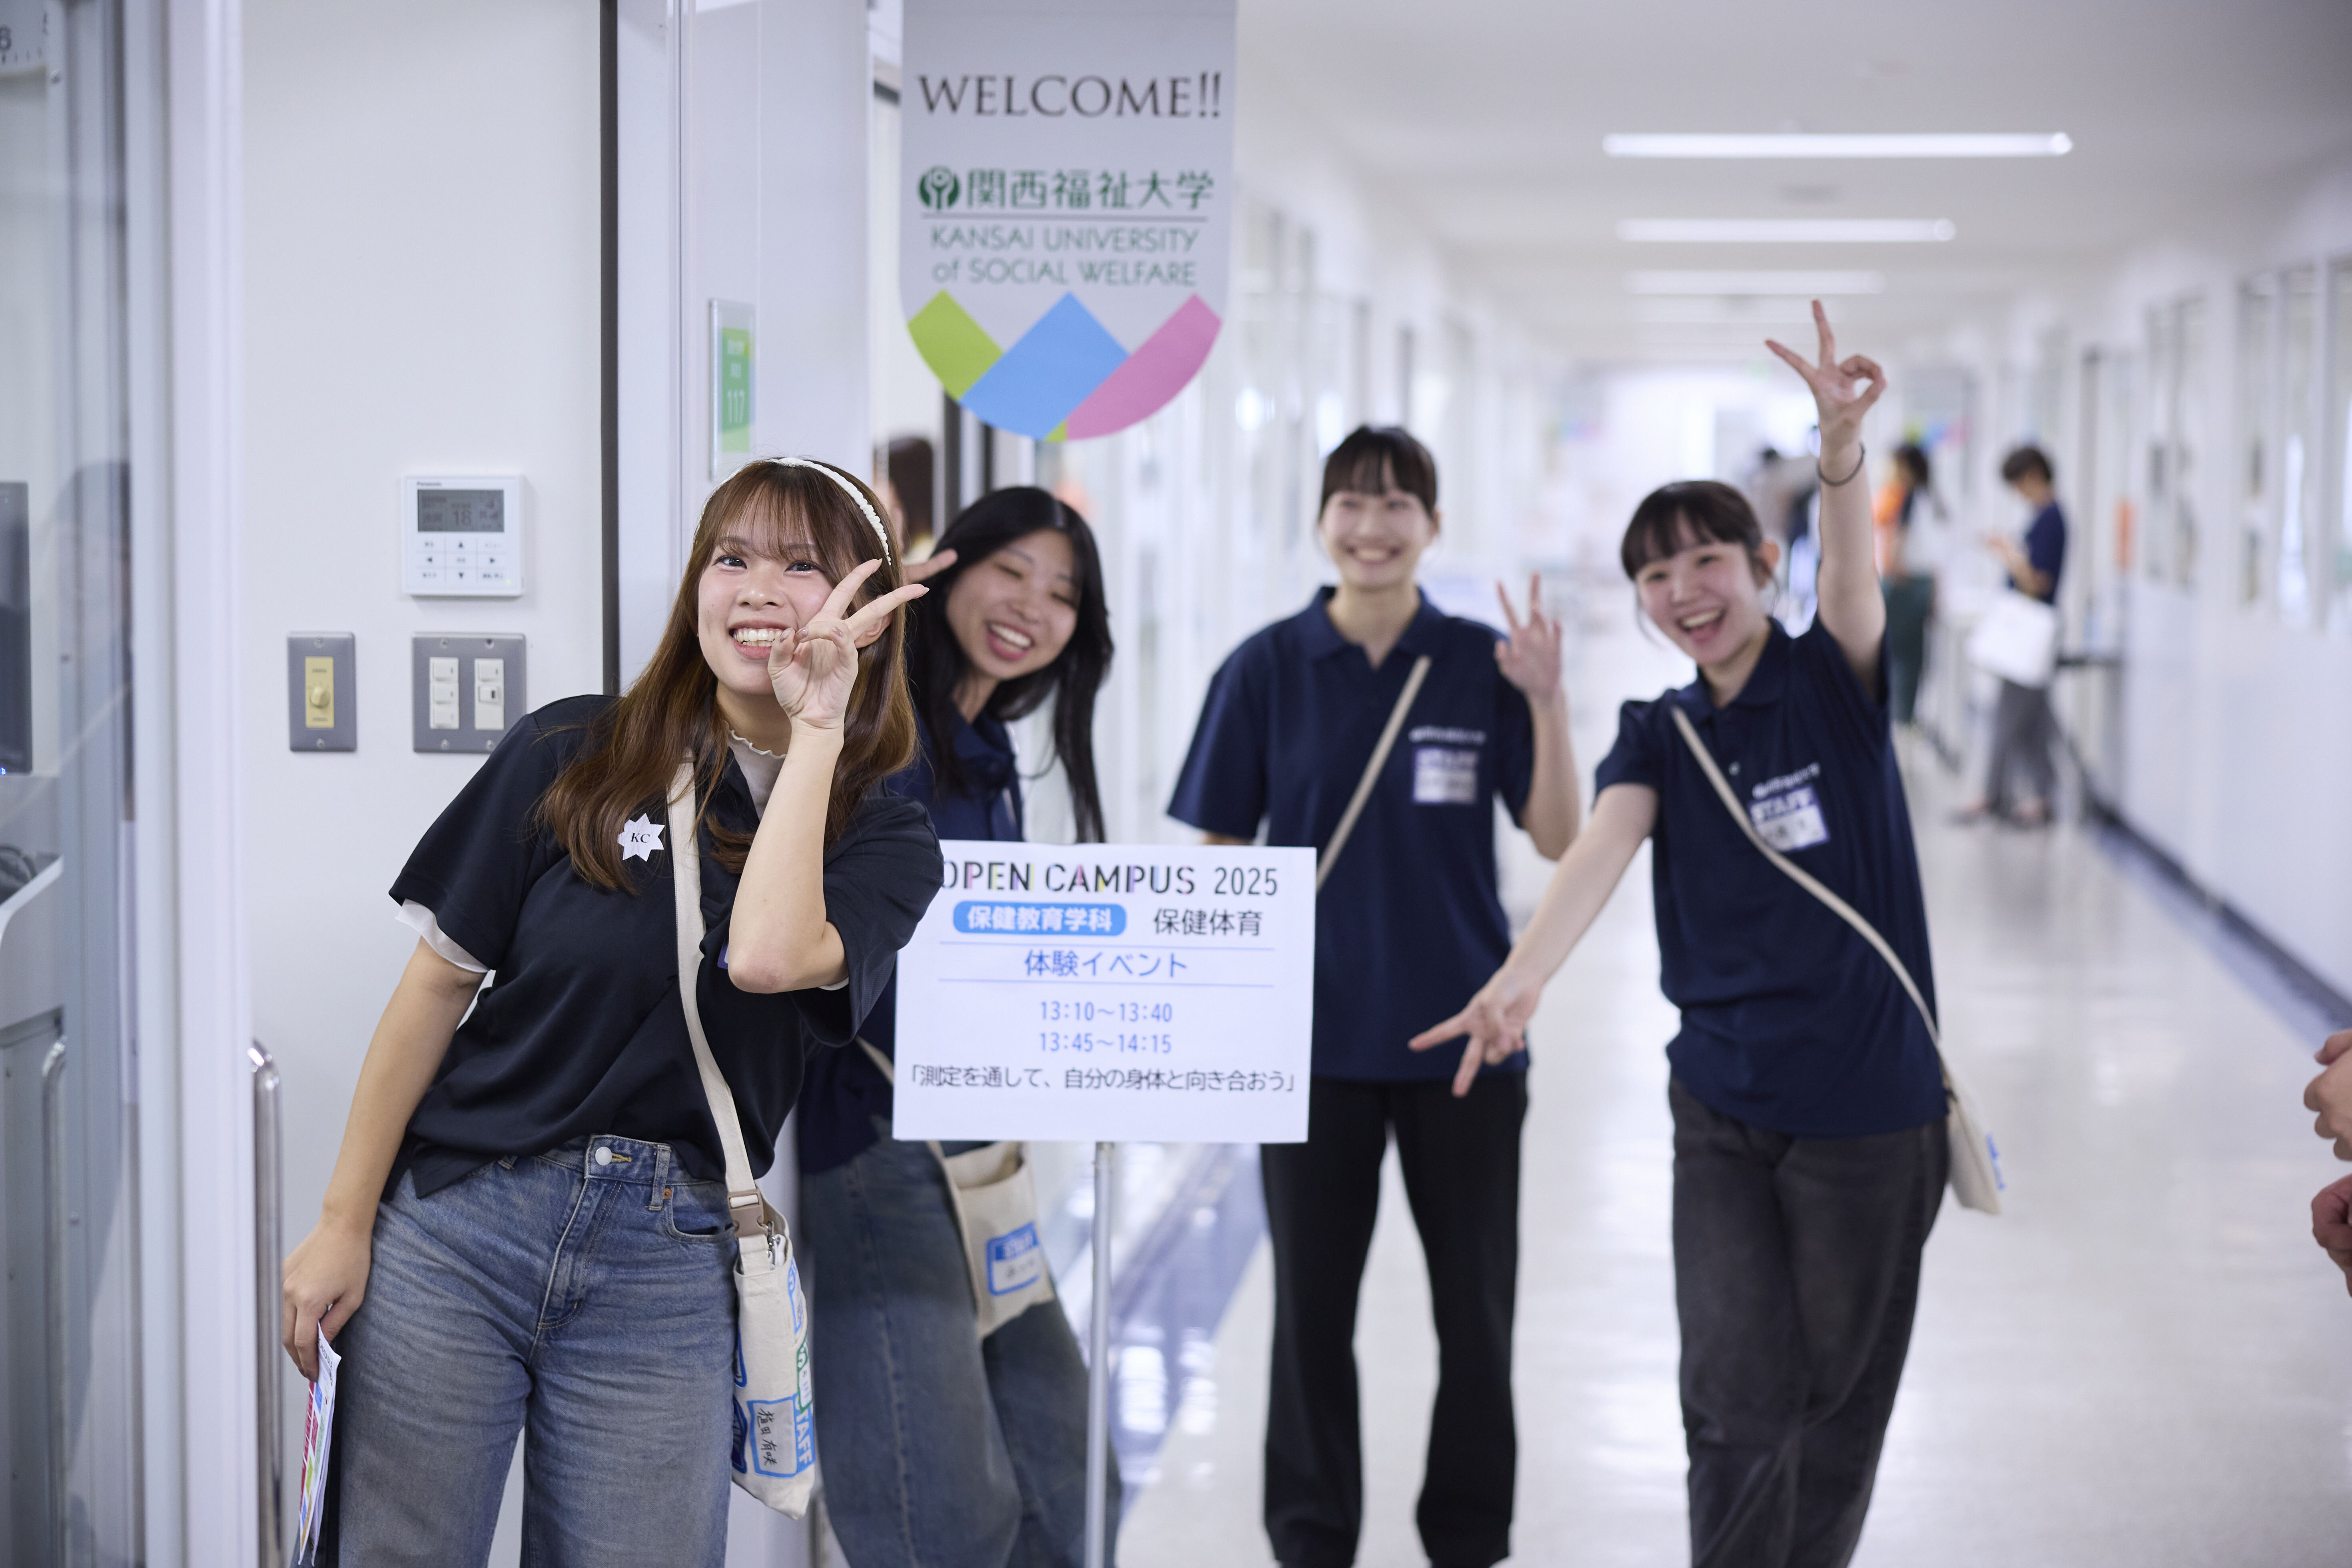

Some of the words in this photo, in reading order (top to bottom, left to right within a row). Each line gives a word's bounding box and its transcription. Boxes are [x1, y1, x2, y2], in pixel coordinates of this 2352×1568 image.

[918, 71, 1221, 118] WELCOME!!
[968, 168, 1215, 210] 関西福祉大学
[931, 225, 1034, 250] KANSAI
[1043, 227, 1200, 253] UNIVERSITY
[932, 258, 961, 283] of
[968, 259, 1069, 285] SOCIAL
[1078, 260, 1198, 287] WELFARE
[631, 833, 650, 843] KC
[1045, 864, 1196, 895] CAMPUS
[1214, 867, 1278, 896] 2025
[967, 906, 1113, 932] 保健教育学科
[1153, 908, 1263, 936] 保健体育
[1024, 949, 1188, 978] 体験イベント
[912, 1065, 1295, 1092] 「測定を通して、自分の身体と向き合おう」
